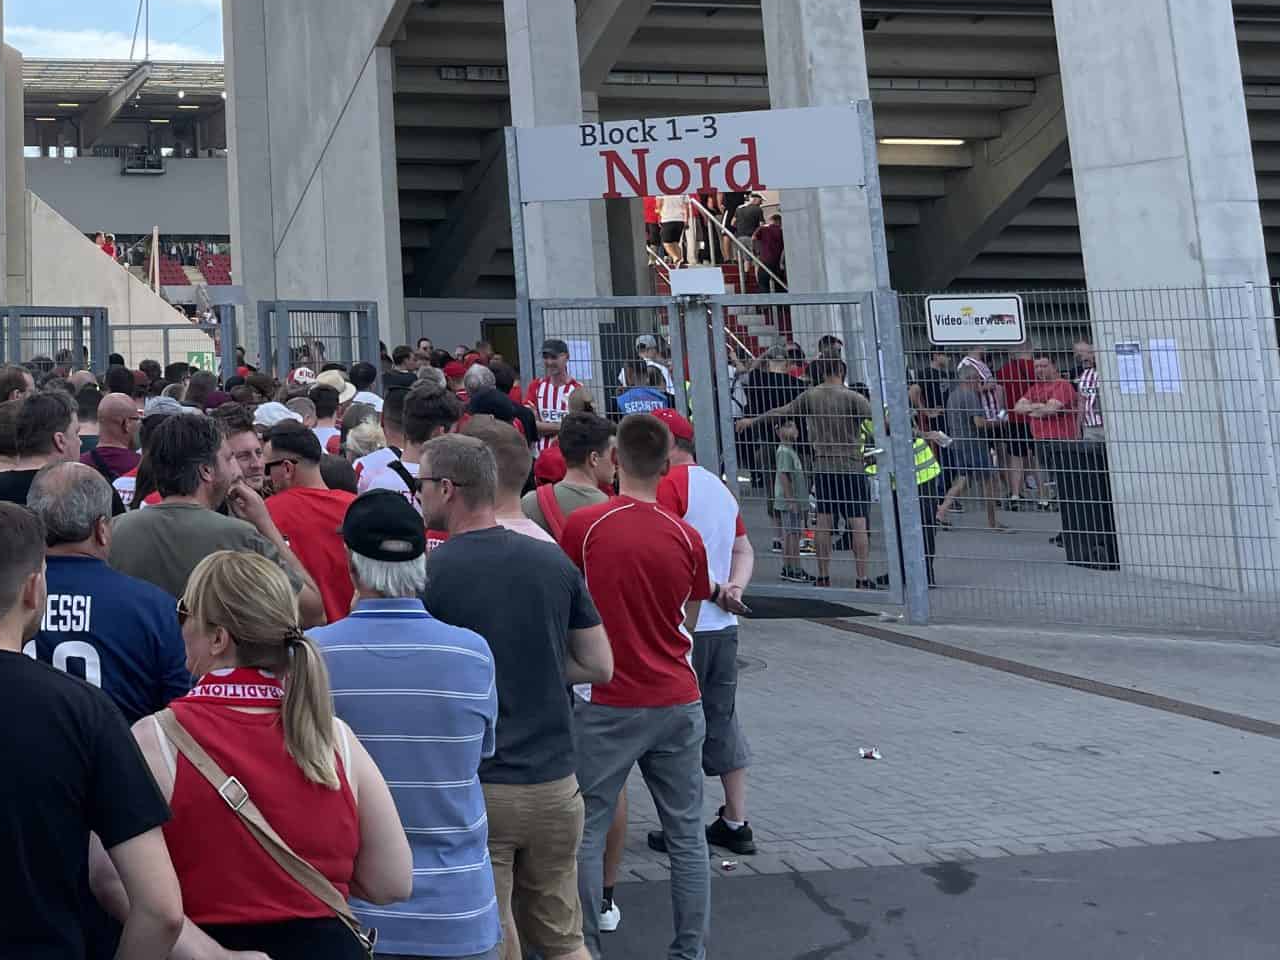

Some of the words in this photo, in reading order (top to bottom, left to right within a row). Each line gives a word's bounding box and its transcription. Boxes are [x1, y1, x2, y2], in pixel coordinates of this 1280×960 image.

[579, 120, 658, 146] Block
[665, 116, 718, 141] 1-3
[599, 136, 766, 199] Nord
[624, 400, 665, 413] SECURITY
[41, 594, 91, 632] ESSI
